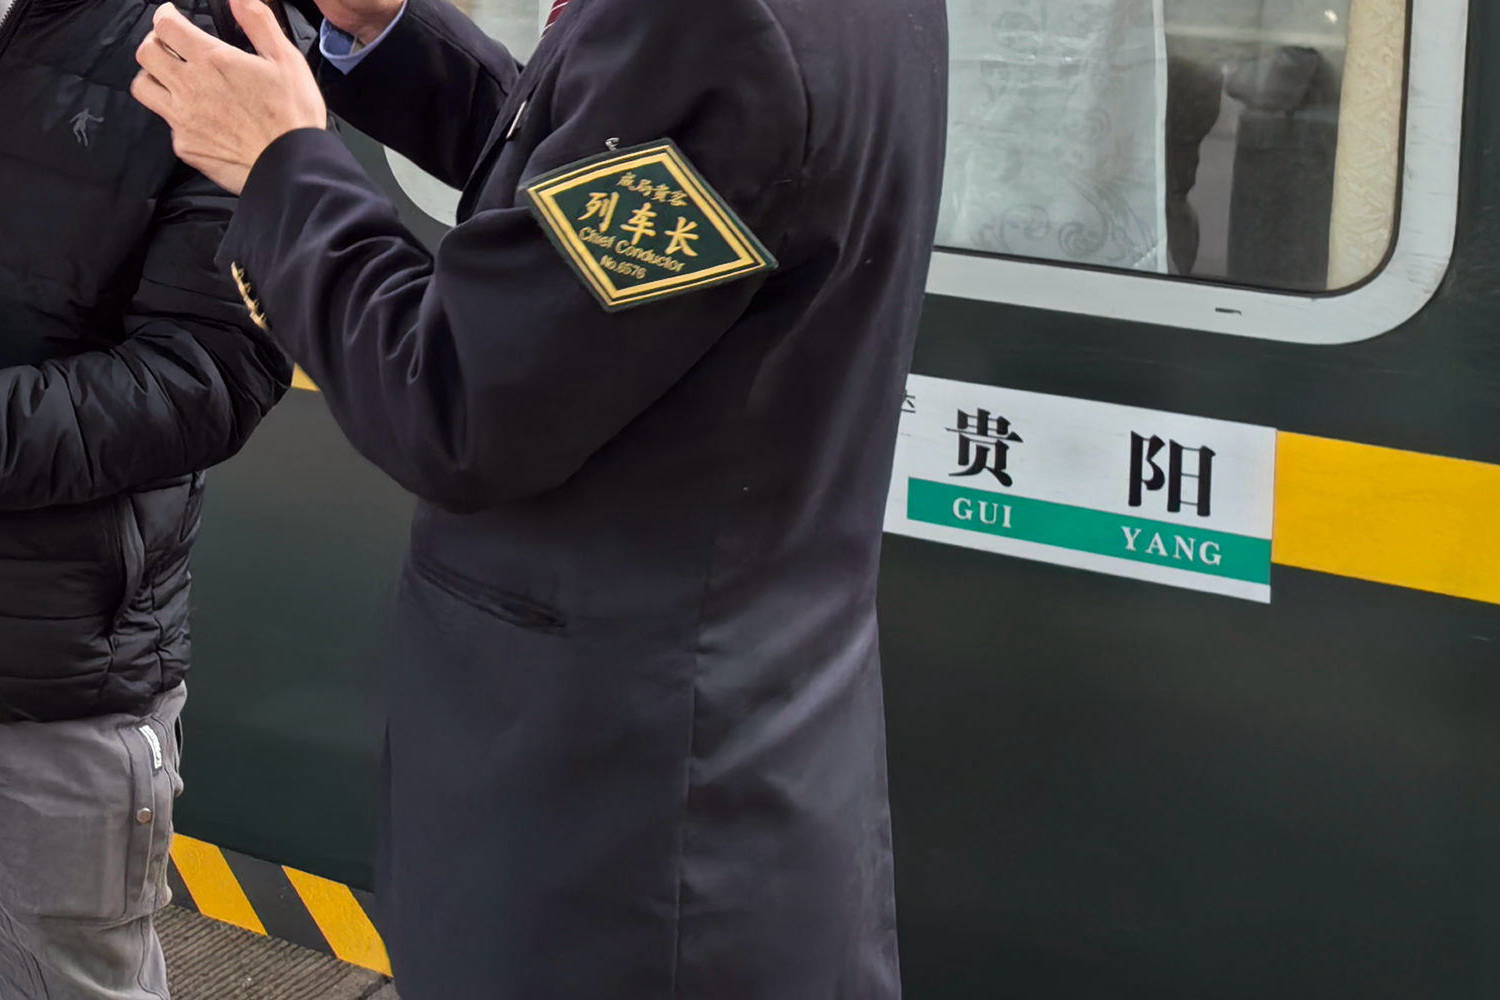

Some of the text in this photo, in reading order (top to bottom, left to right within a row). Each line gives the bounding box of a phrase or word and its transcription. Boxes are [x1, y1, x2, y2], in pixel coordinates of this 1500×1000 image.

[577, 191, 700, 257] 列车长
[614, 239, 687, 273] Conductor
[943, 407, 1217, 518] 贵阳
[951, 496, 1223, 567] GUI YANG
